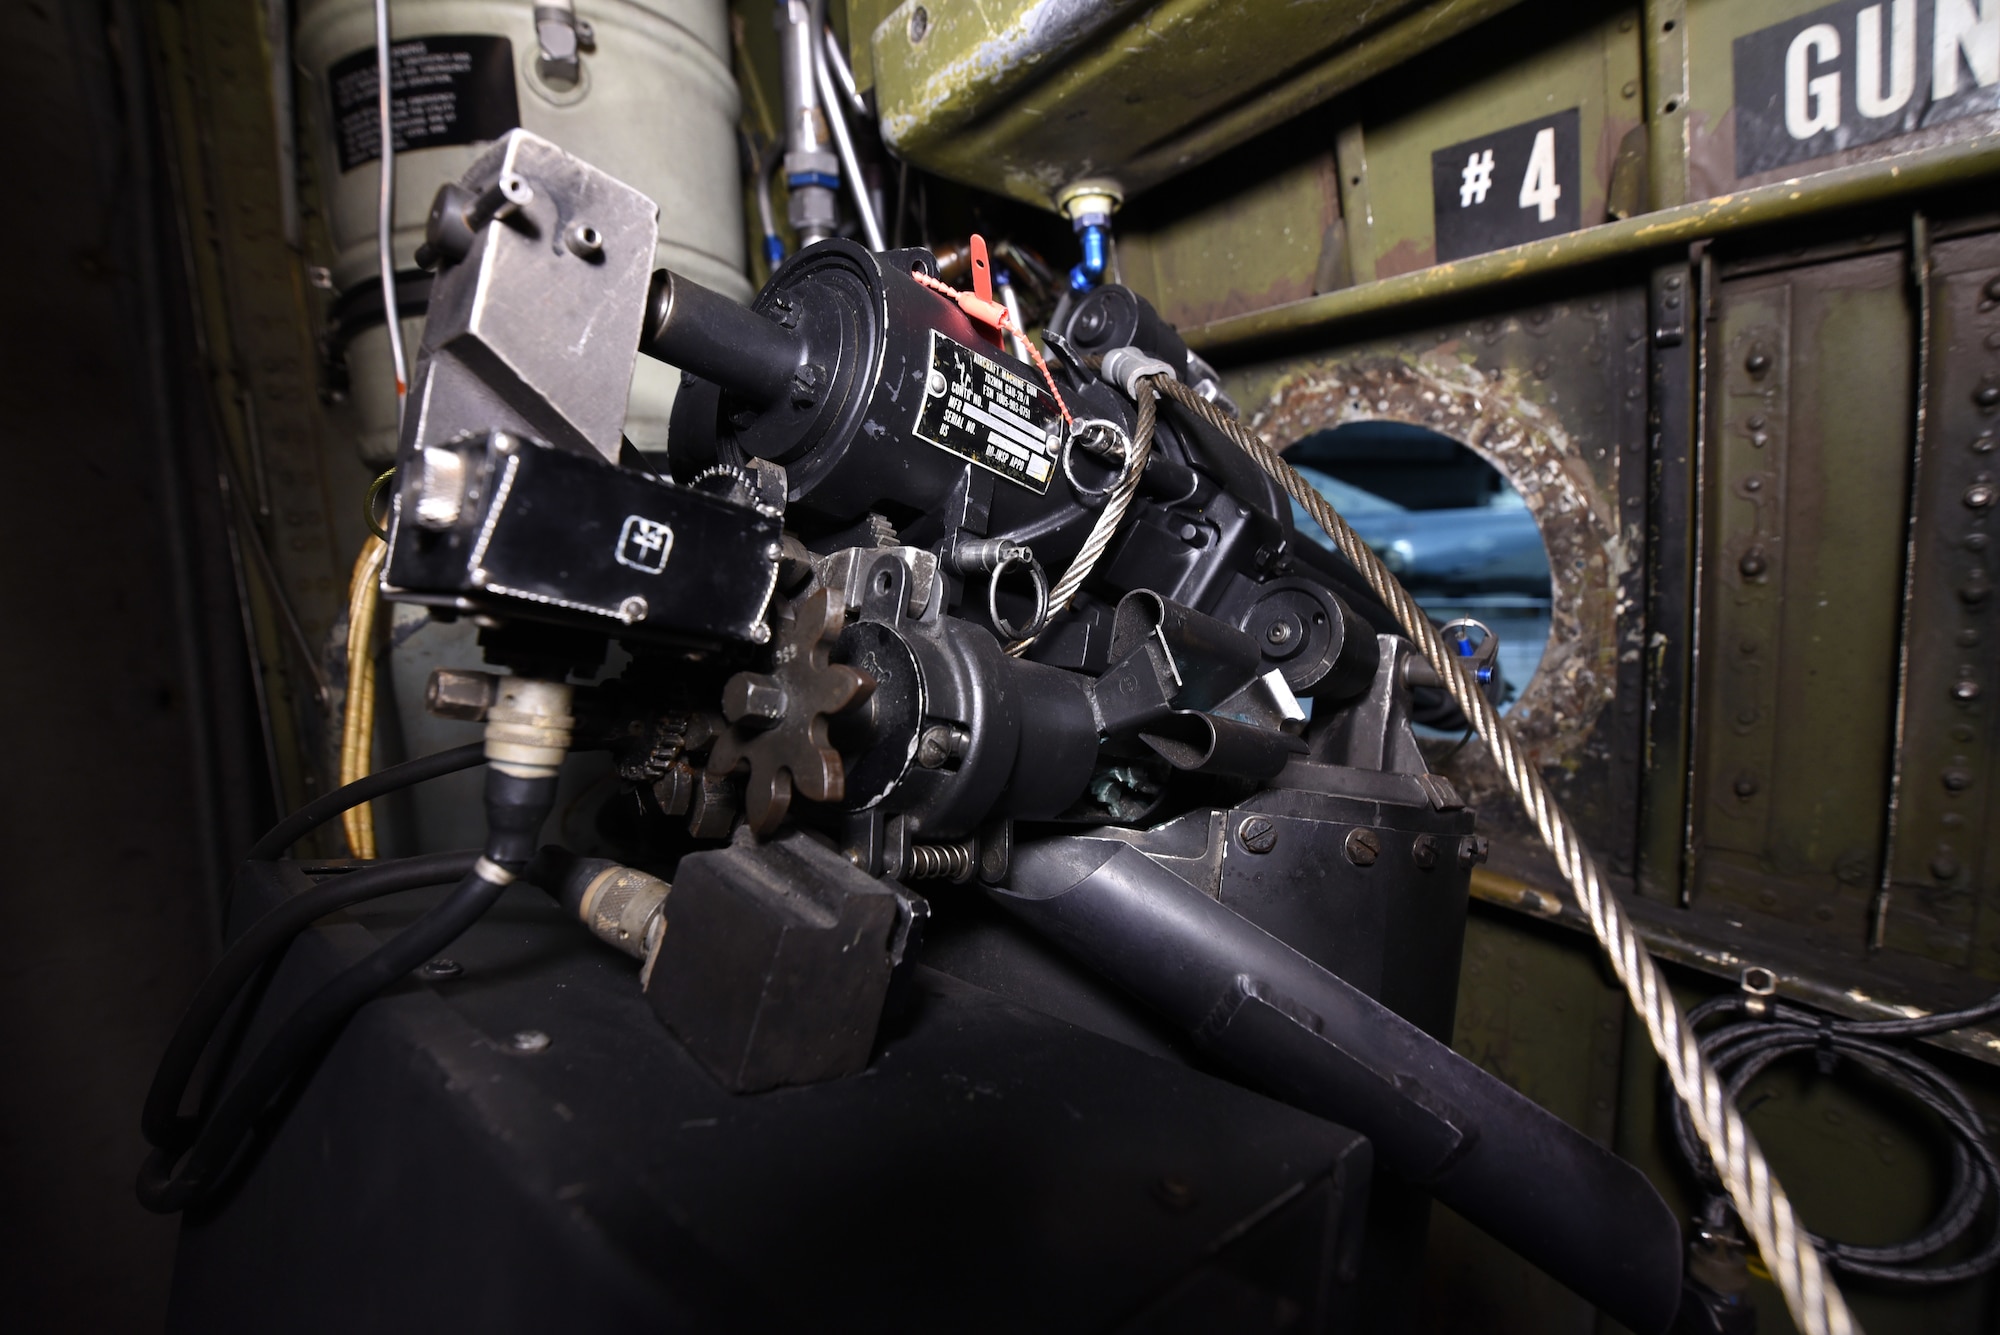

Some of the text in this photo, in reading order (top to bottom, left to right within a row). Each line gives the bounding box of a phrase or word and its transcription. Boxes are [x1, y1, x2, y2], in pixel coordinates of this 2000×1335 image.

[1459, 127, 1561, 223] # 4
[973, 353, 1038, 398] AIRCRAFT MACHINE GUN
[947, 394, 963, 412] MFR
[951, 380, 983, 408] CONTR NO.
[982, 383, 995, 400] FSN
[1004, 383, 1030, 406] GAU-2B/A
[939, 422, 950, 437] US
[943, 408, 976, 435] SERIAL NO.
[1009, 456, 1025, 472] APPD
